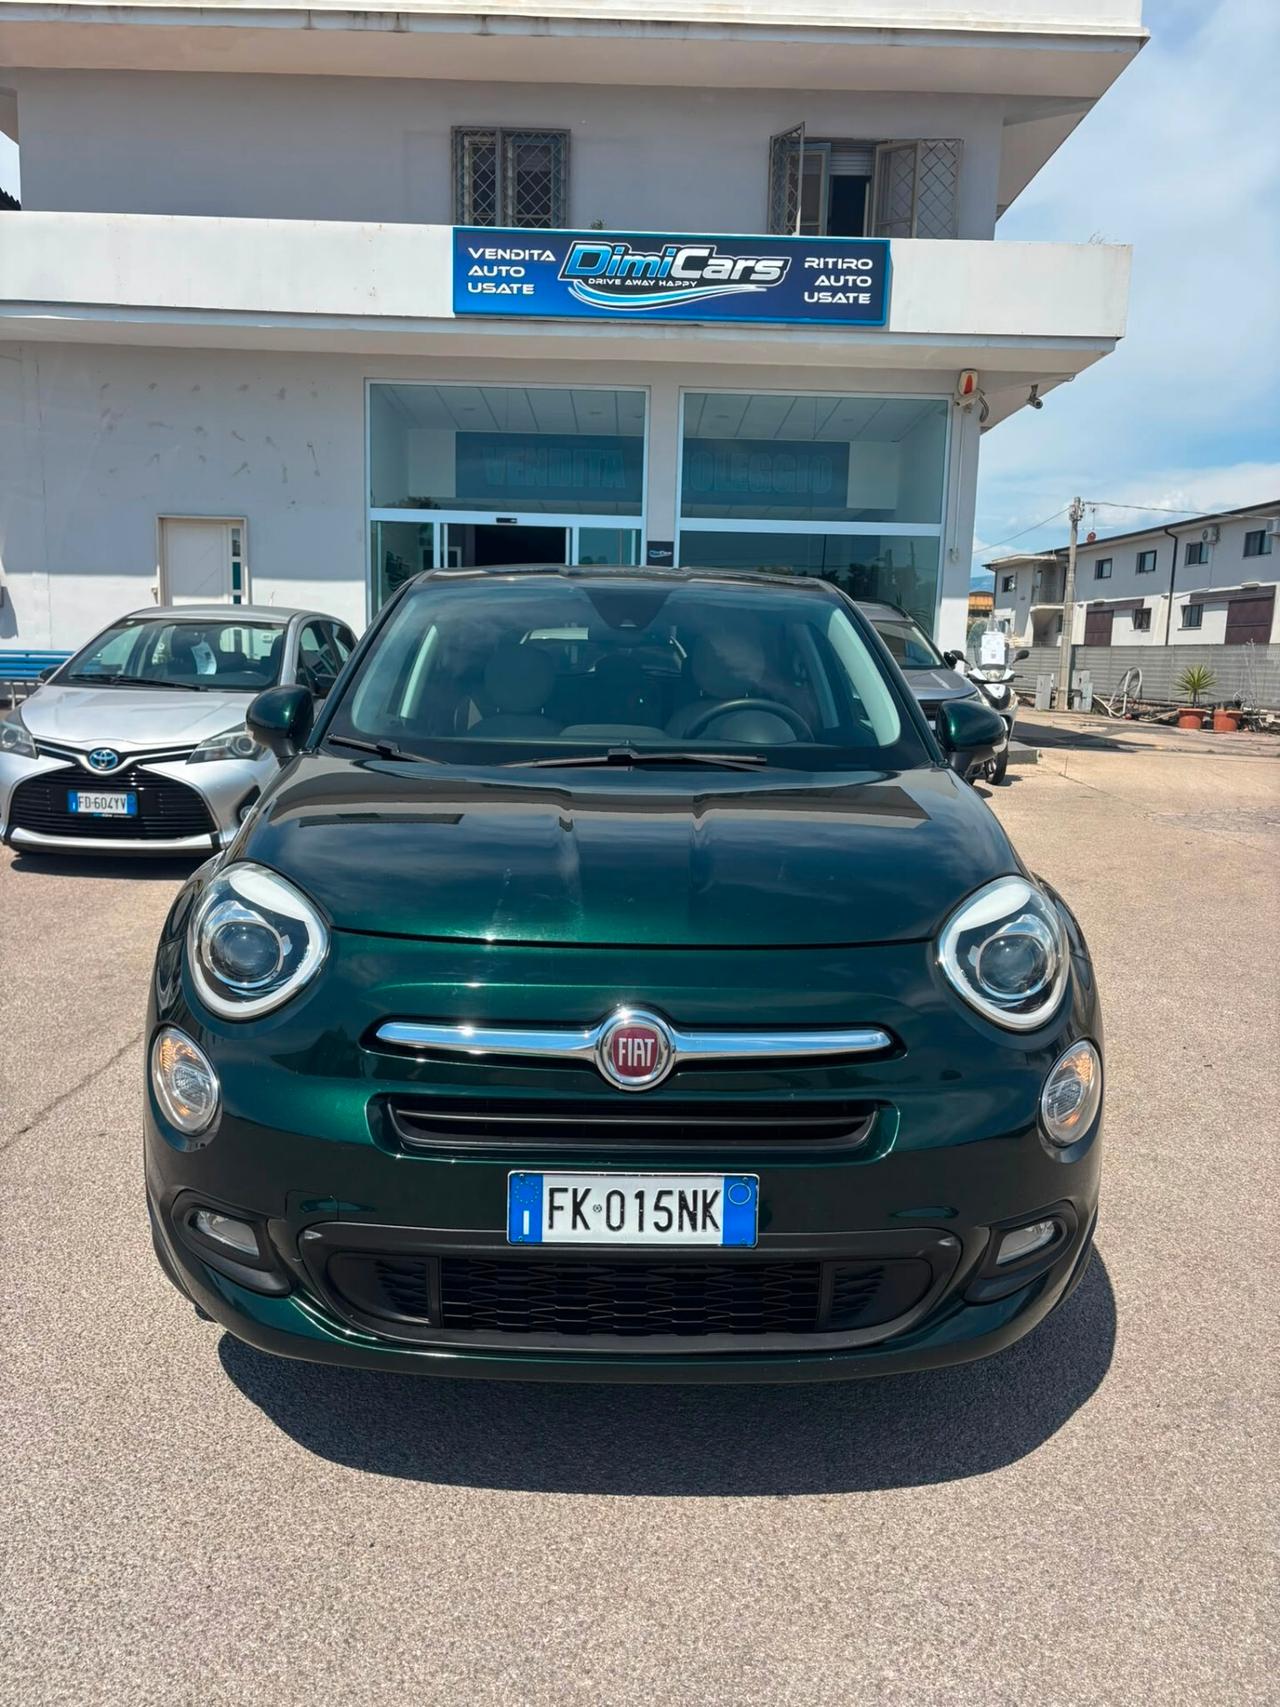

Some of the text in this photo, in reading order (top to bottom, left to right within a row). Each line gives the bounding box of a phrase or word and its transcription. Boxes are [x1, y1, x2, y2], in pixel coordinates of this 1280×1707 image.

[467, 247, 557, 262] VENDITA
[564, 243, 785, 281] DimiCars
[804, 257, 873, 270] RITIRO
[467, 264, 526, 278] AUTO
[588, 277, 698, 289] DRIVE AWAY HAPPY
[814, 274, 872, 287] AUTO
[467, 282, 535, 295] USATE
[803, 291, 872, 304] USATE
[682, 449, 833, 494] OLEGGIO
[618, 1037, 655, 1068] FIAT
